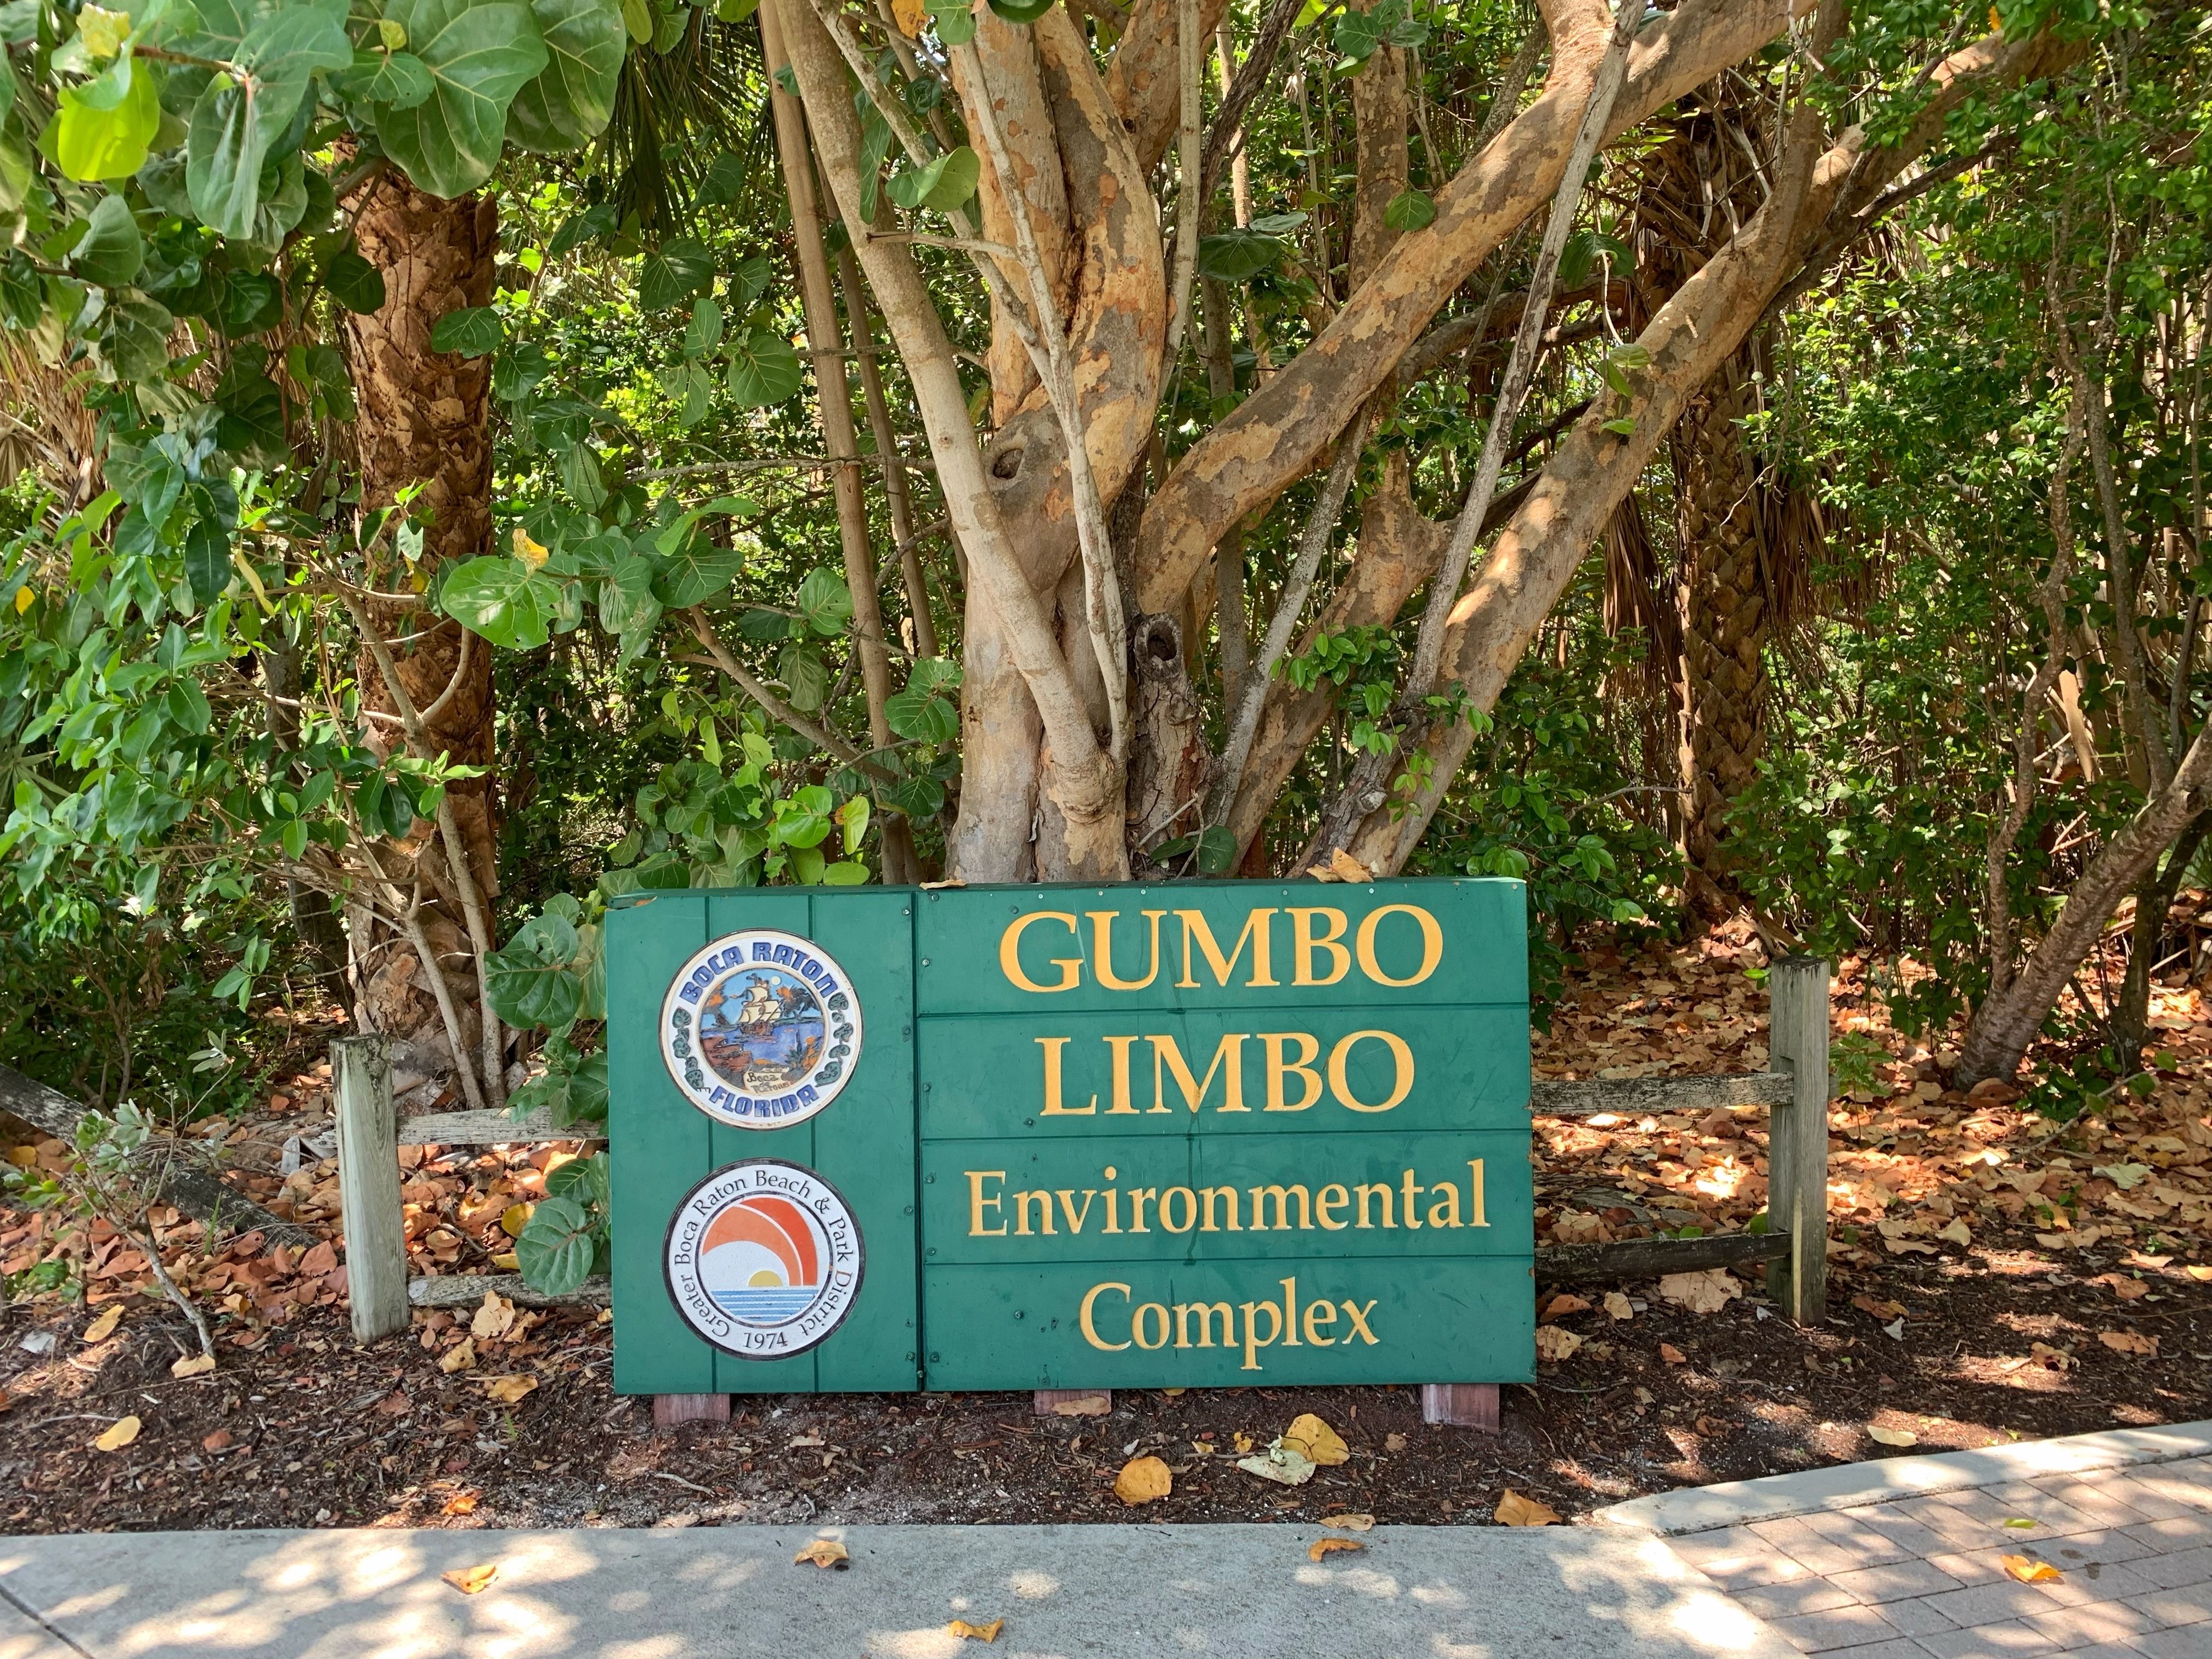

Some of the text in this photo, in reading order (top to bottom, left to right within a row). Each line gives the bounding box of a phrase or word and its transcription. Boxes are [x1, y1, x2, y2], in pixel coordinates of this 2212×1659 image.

[679, 941, 838, 1005] BOCA RATON
[1000, 904, 1443, 992] GUMBO
[709, 1084, 819, 1118] FLORIDA
[1035, 1030, 1414, 1116] LIMBO
[963, 1159, 1491, 1236] Environmental
[674, 1170, 853, 1338] Greater Boca Raton Beach & Park District
[742, 1332, 788, 1349] 1974
[1080, 1276, 1379, 1370] Complex
